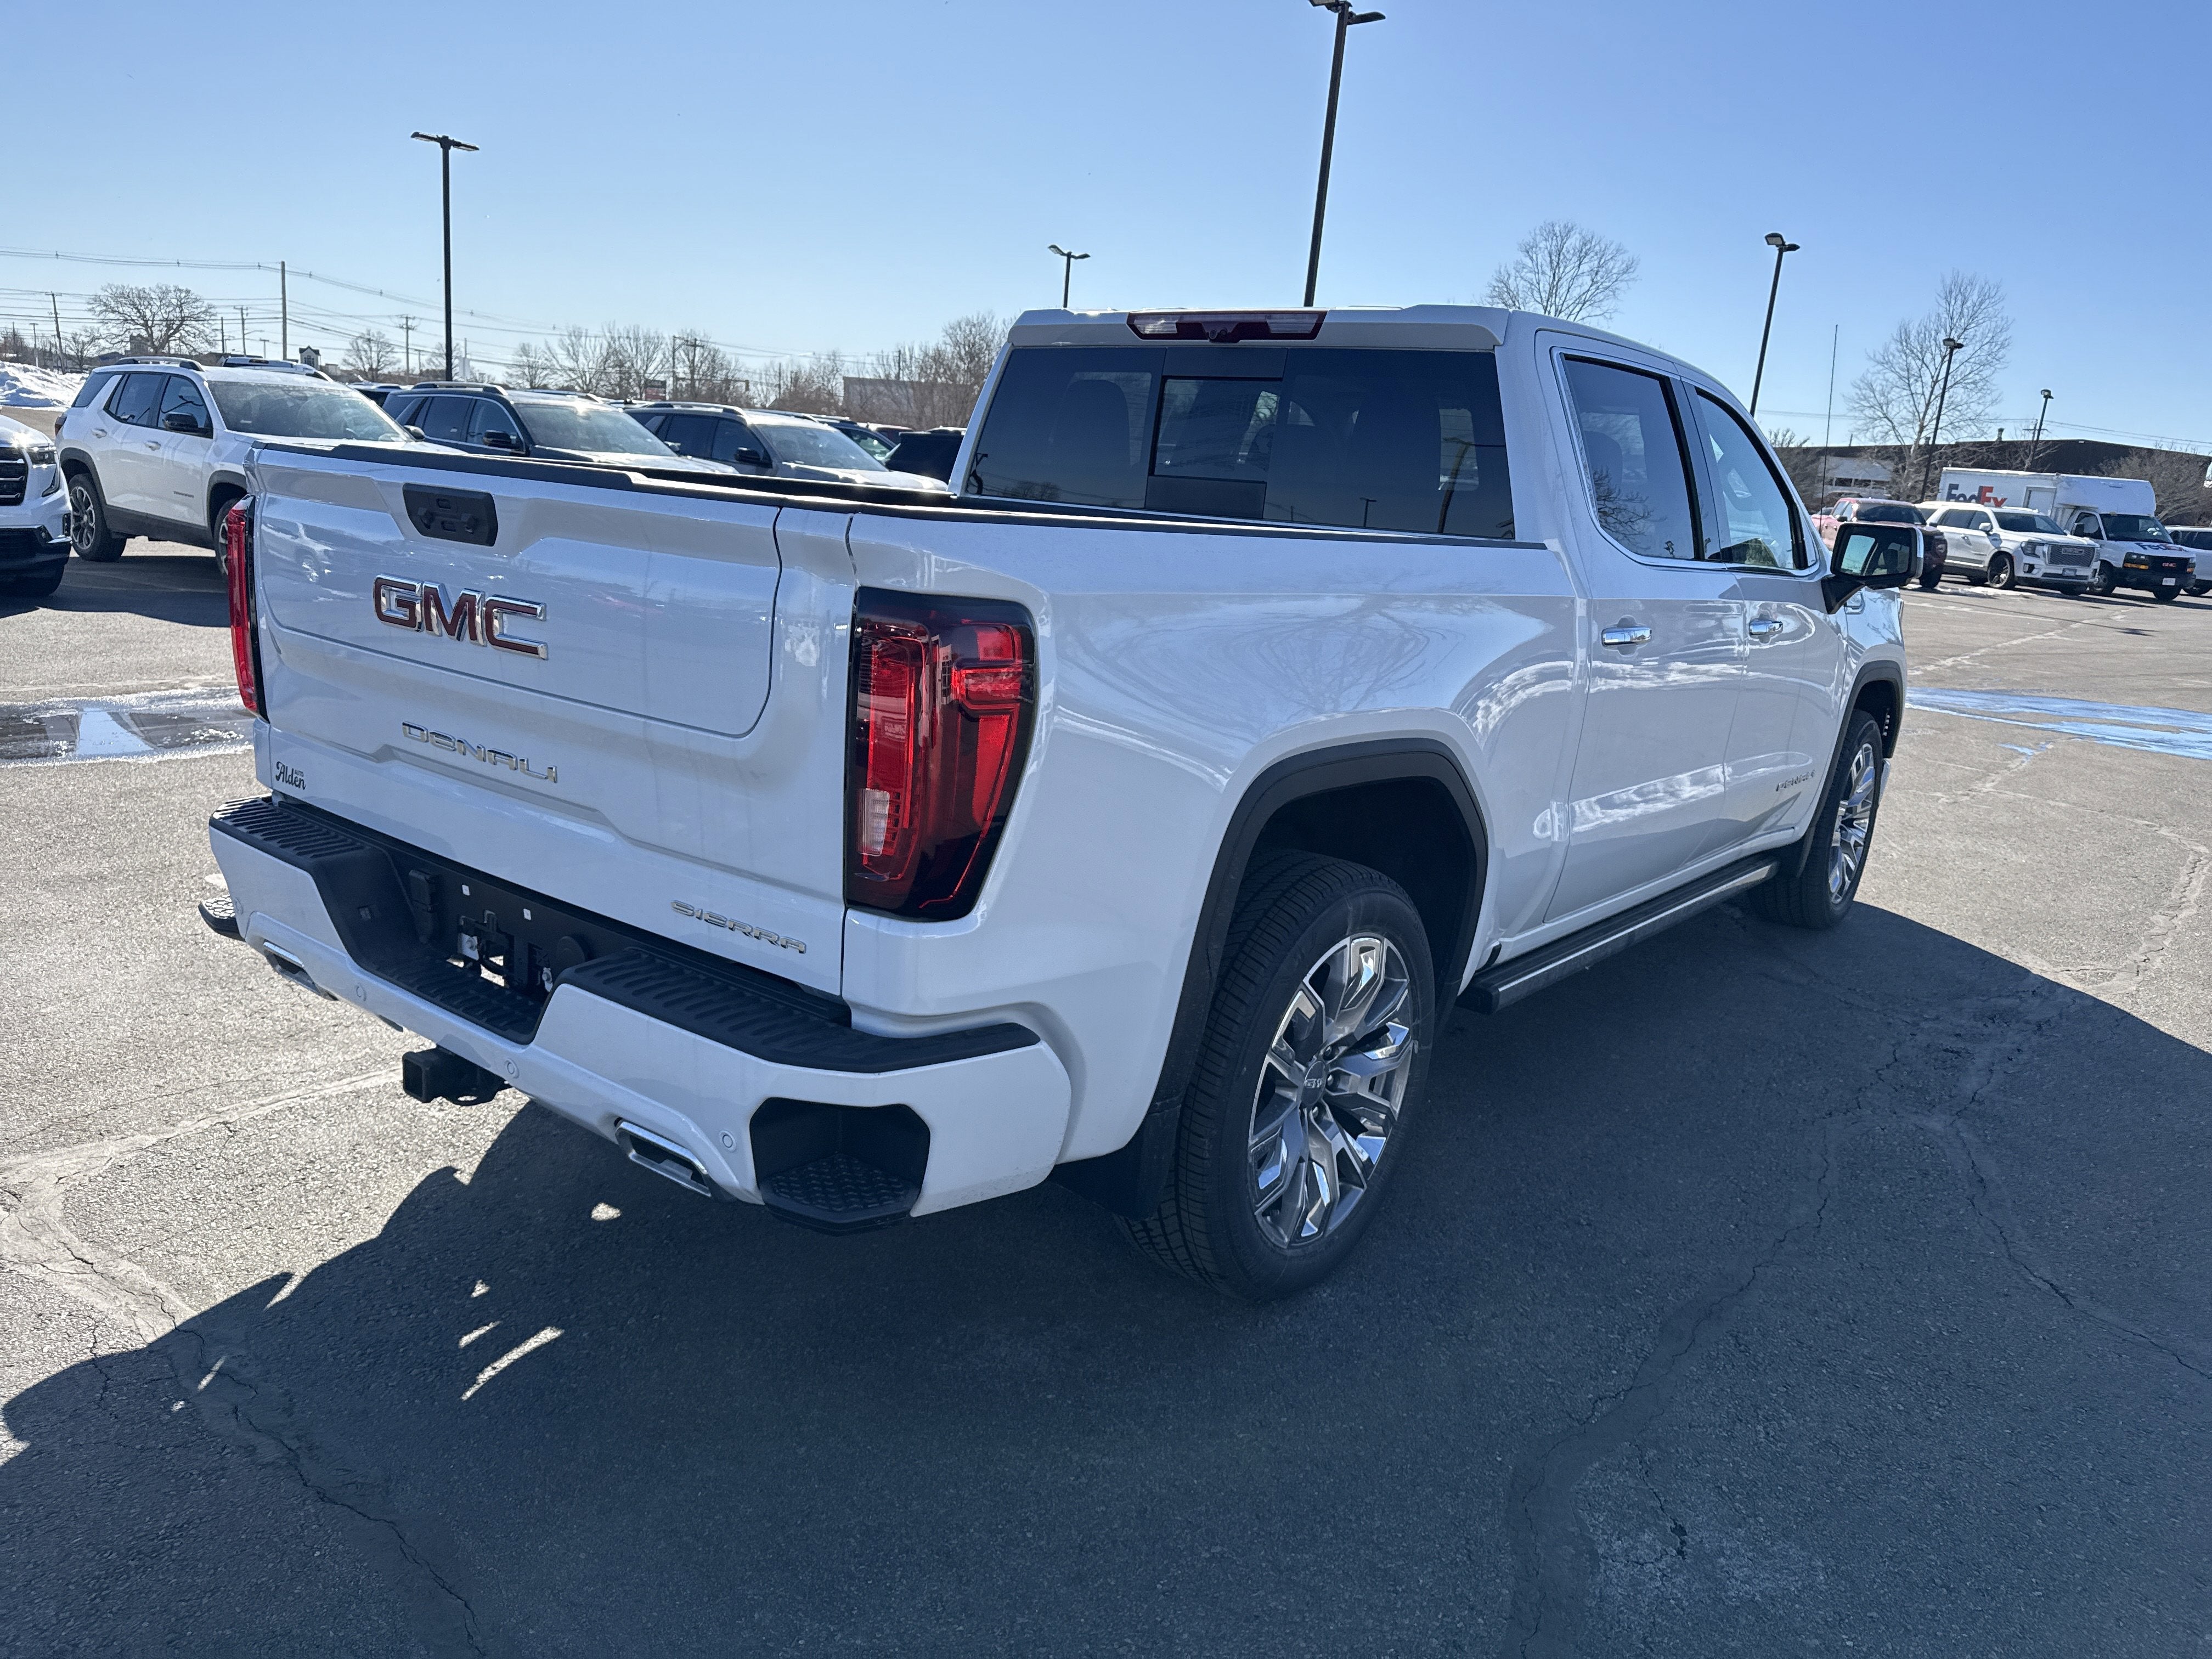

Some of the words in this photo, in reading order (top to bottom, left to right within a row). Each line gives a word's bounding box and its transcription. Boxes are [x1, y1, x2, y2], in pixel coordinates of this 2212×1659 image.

[373, 574, 548, 660] GMC
[275, 761, 306, 790] Alden
[402, 721, 557, 783] DENALI
[671, 900, 807, 954] SIERRA
